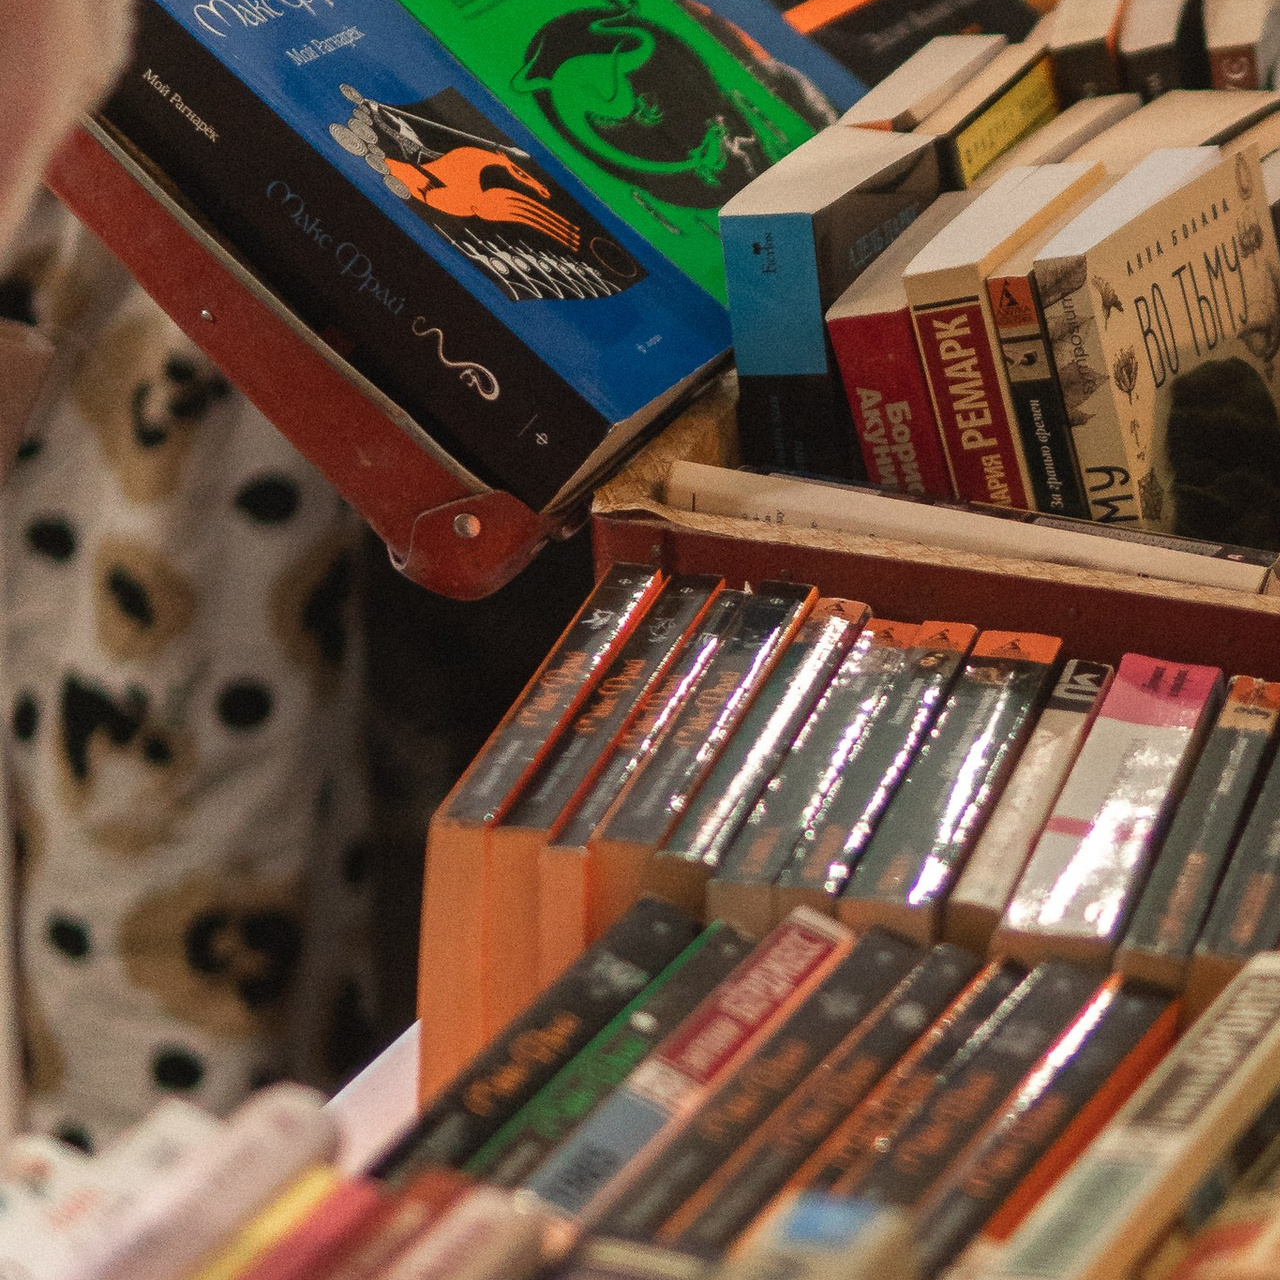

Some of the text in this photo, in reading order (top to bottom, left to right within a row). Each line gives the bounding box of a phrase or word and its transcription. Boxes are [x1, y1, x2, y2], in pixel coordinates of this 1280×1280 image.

[285, 24, 365, 67] Мой Рагнарёк
[143, 68, 220, 143] Мой Рагнарёк
[265, 179, 405, 315] Макс Фрай
[1126, 239, 1164, 277] АННА
[1134, 235, 1249, 390] ВО ТЬМУ
[856, 387, 897, 487] Акуни
[936, 313, 1012, 508] АРИЯ РЕМАРК
[1041, 447, 1065, 493] гранью
[1050, 493, 1064, 509] За
[1084, 465, 1139, 522] МУ
